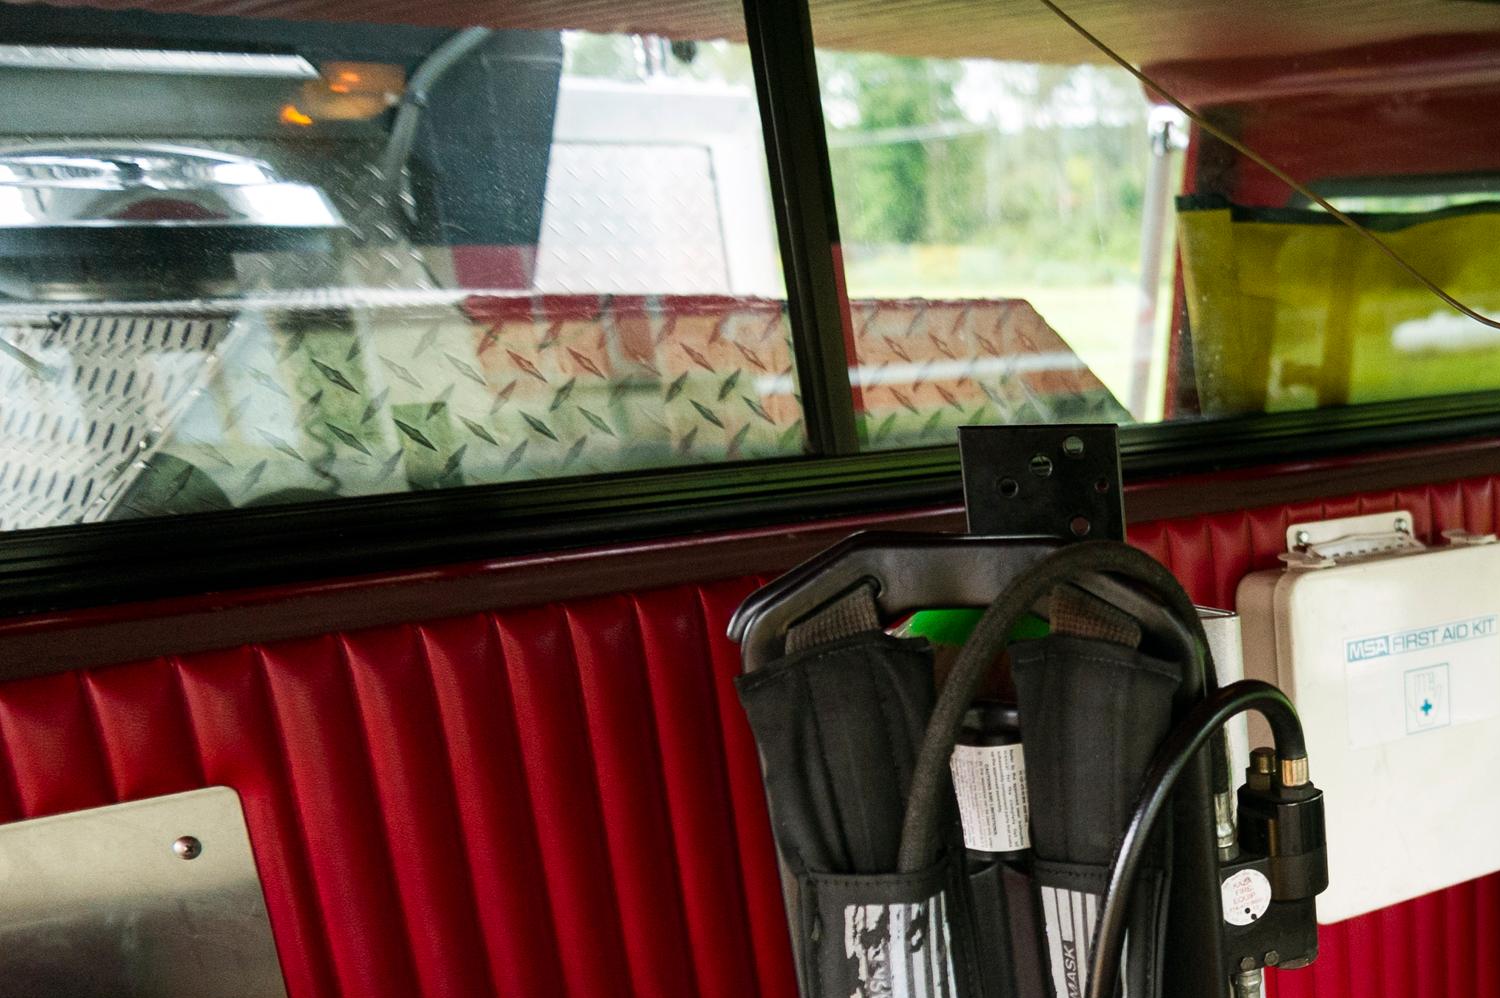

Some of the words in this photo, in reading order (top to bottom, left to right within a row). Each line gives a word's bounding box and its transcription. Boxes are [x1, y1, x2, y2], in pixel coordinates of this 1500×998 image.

[1348, 636, 1389, 662] MSA
[1392, 628, 1438, 651] FIRST
[1441, 623, 1469, 643] AID
[1471, 617, 1495, 637] KIT
